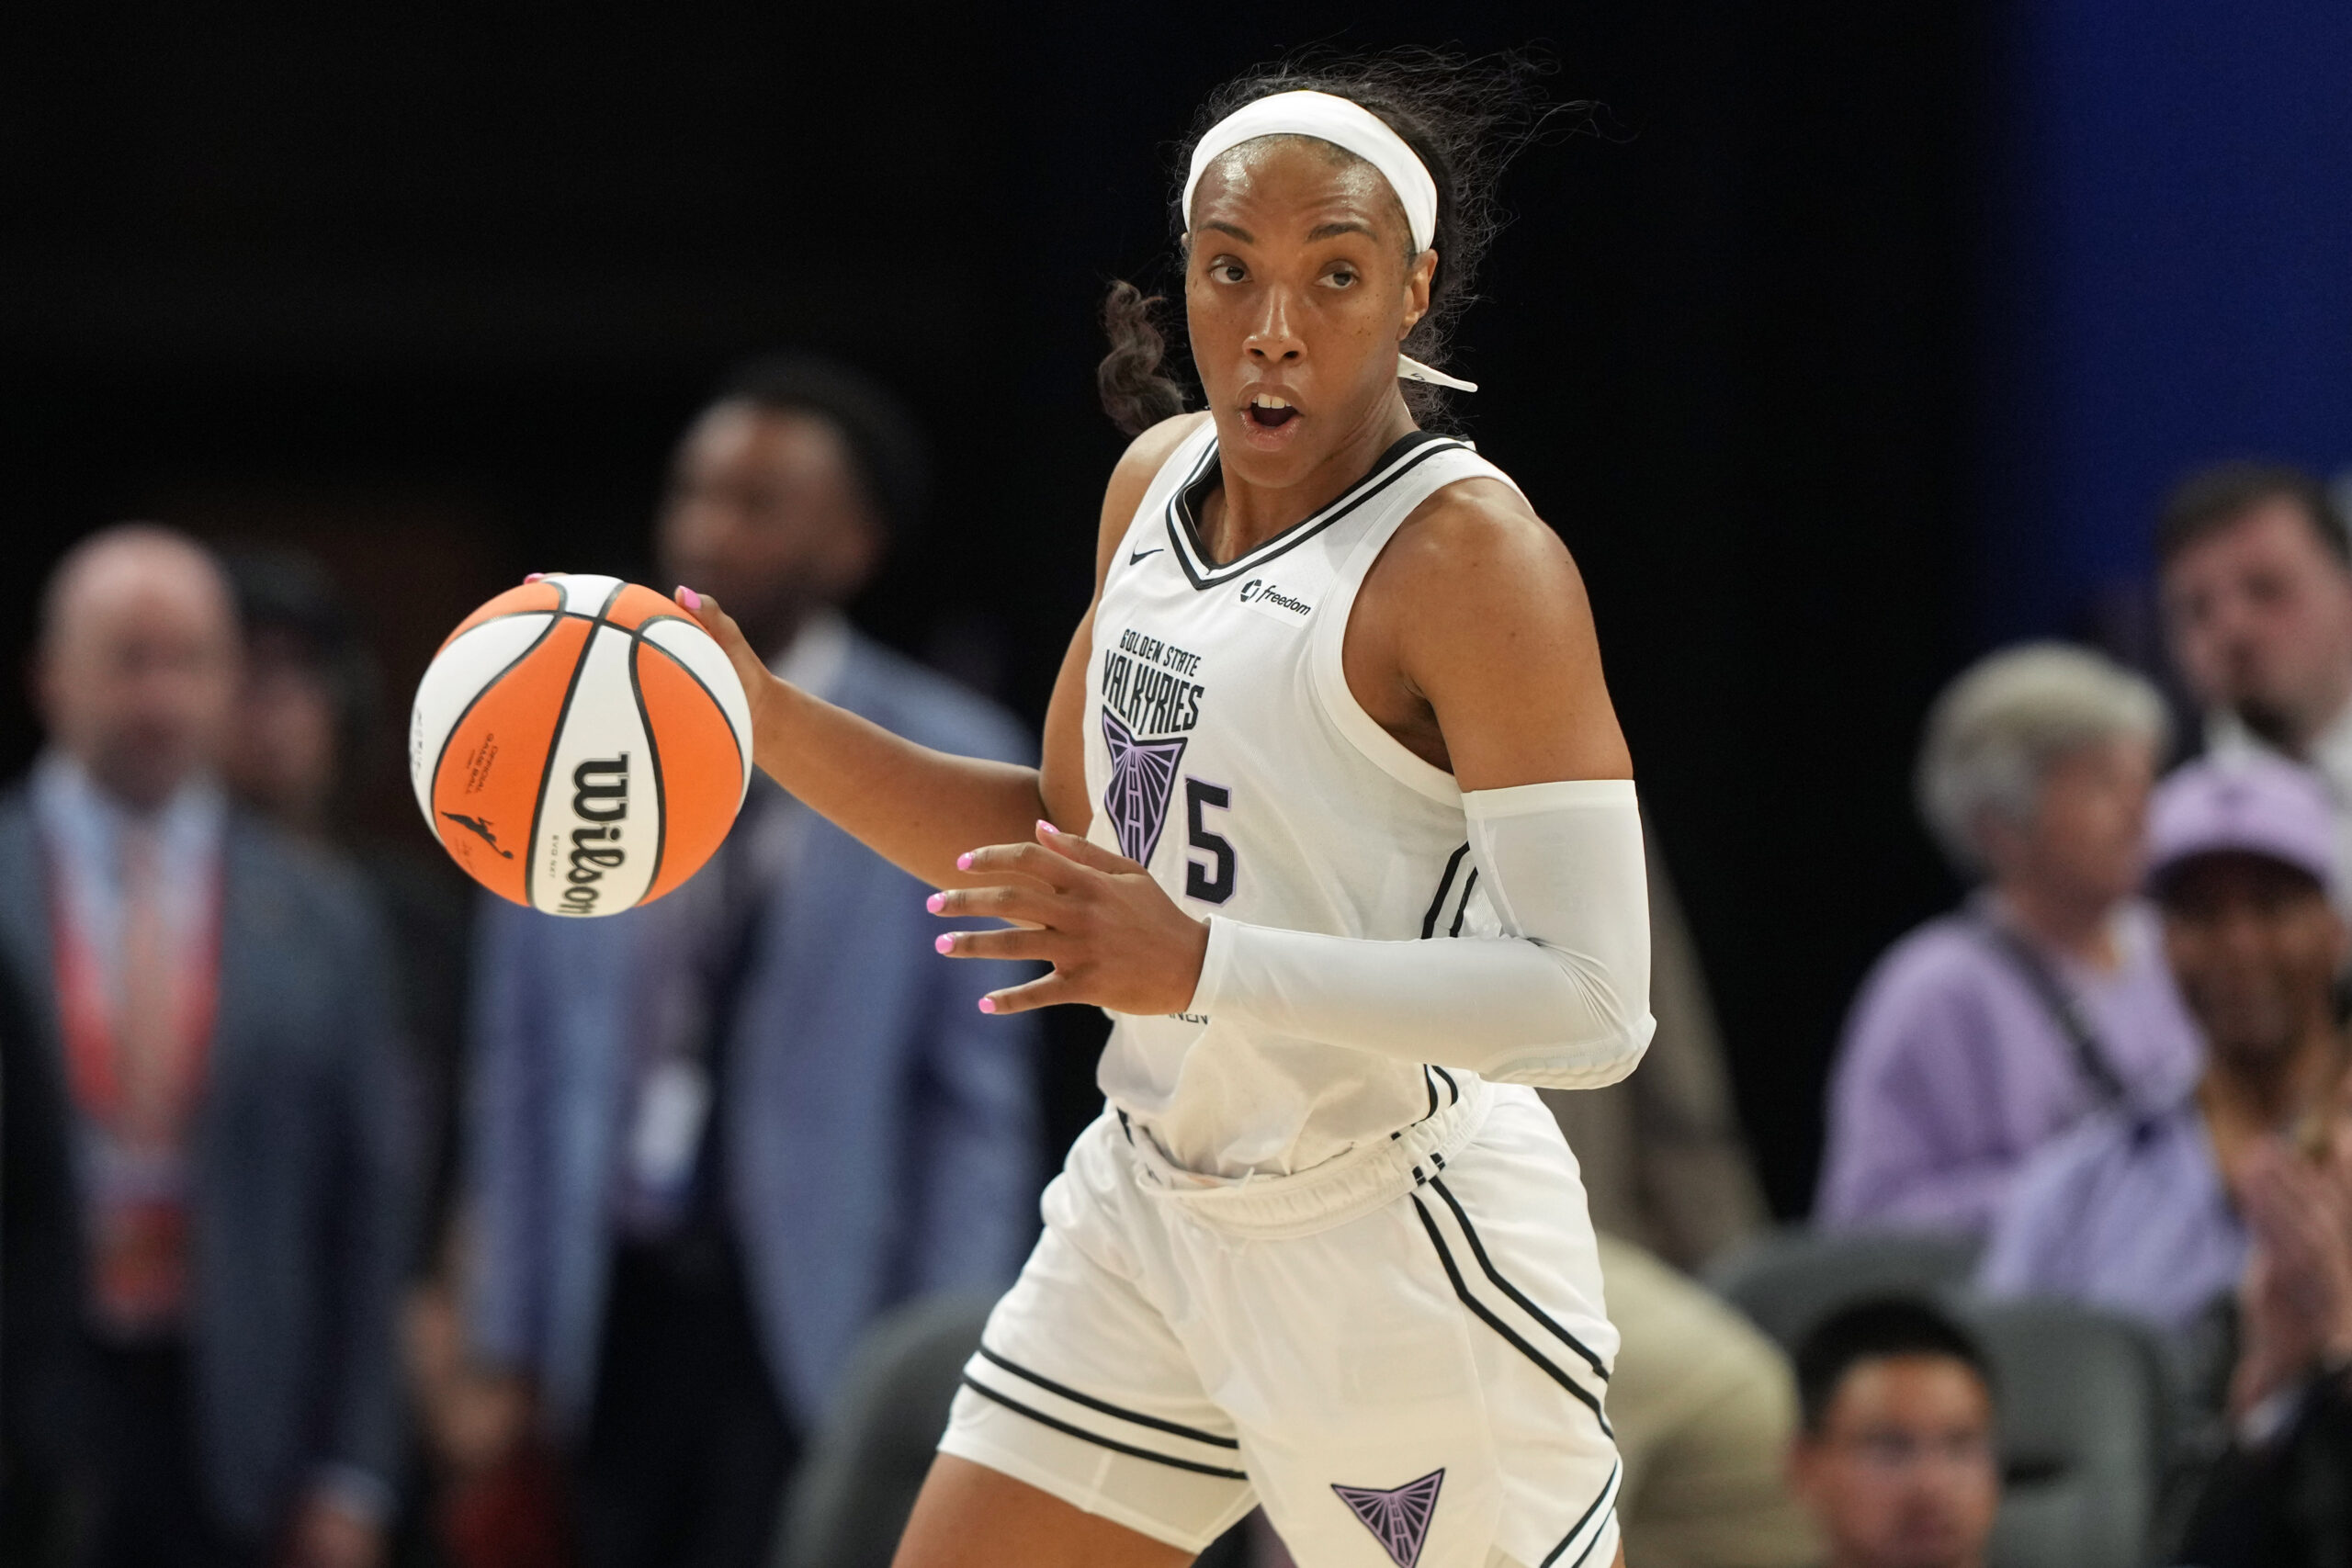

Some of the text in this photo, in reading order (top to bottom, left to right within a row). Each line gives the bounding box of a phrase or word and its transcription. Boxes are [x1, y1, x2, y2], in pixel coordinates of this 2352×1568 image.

[1255, 584, 1311, 615] freedom
[1102, 649, 1205, 735] VALKYRIES
[1119, 628, 1202, 677] GOLDEN STATE
[557, 751, 632, 915] Wilson
[1184, 774, 1238, 908] 5
